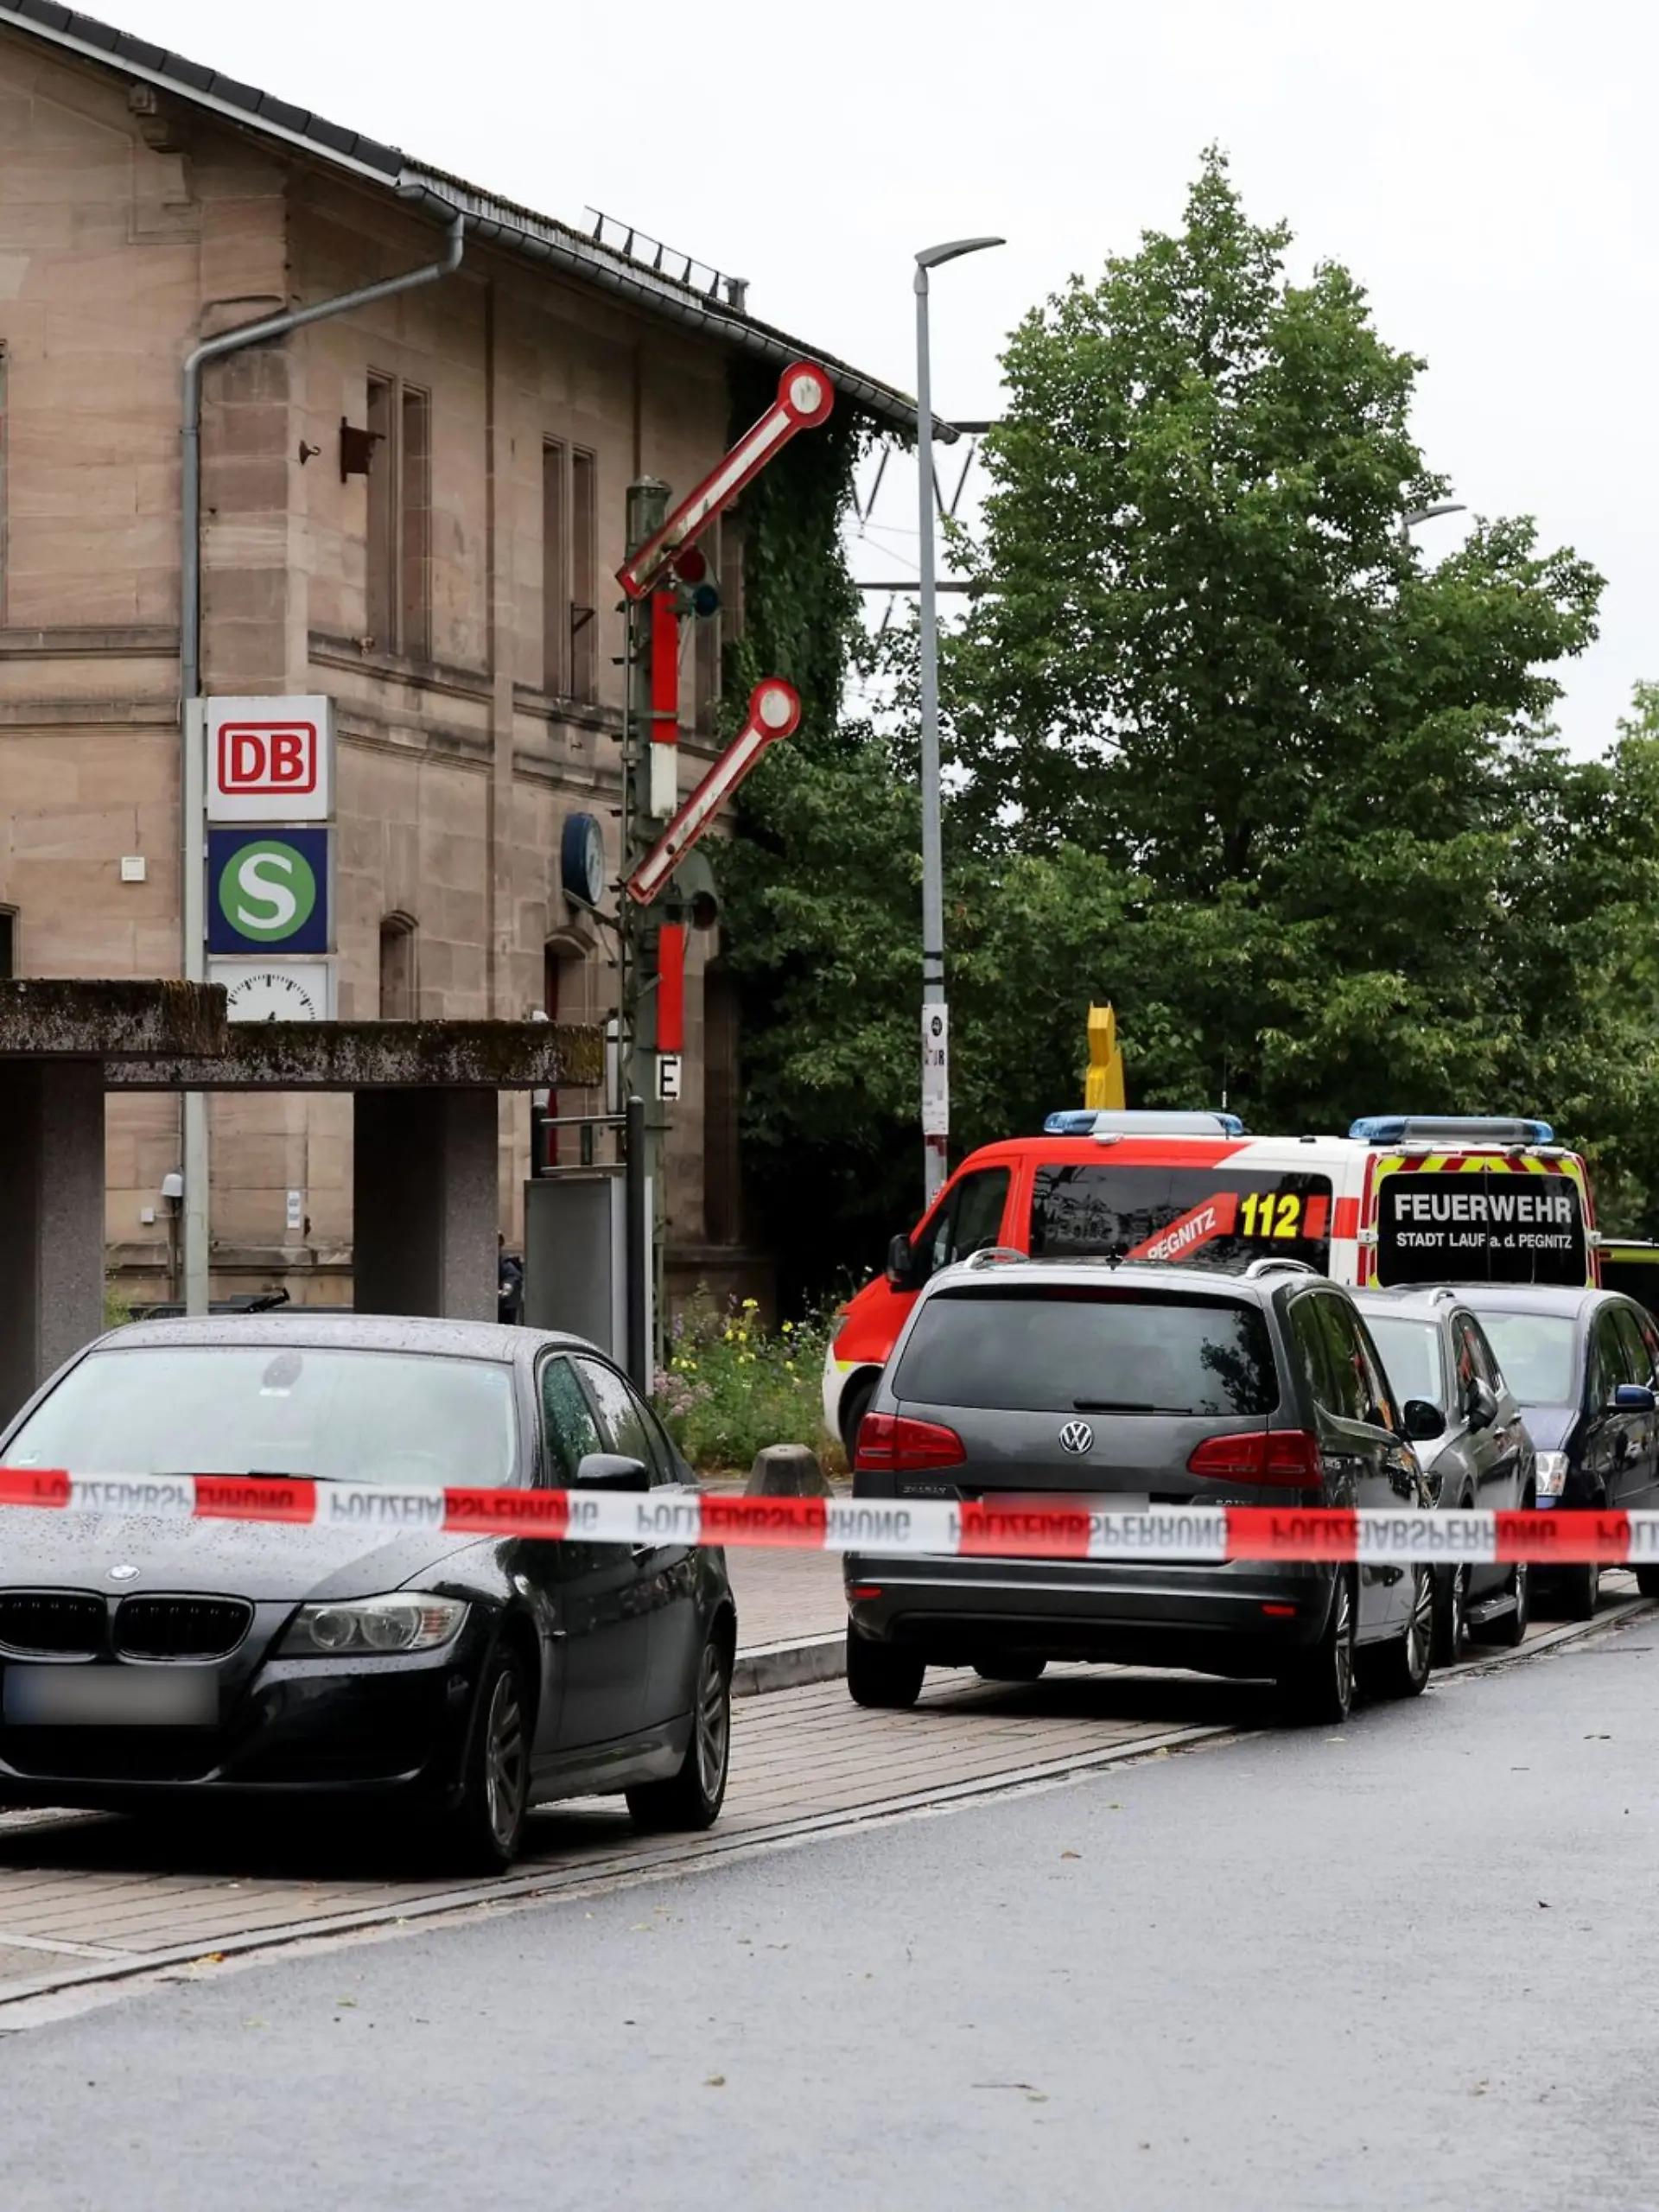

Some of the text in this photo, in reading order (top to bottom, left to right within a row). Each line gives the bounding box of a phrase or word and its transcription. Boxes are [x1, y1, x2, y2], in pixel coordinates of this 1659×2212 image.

[231, 734, 304, 782] DB
[238, 853, 296, 930] S
[660, 1059, 677, 1096] E
[1241, 1192, 1300, 1237] 112
[1394, 1193, 1572, 1224] FEUERWEHR
[1147, 1206, 1217, 1259] PEGNITZ
[1396, 1232, 1572, 1249] STADT LAUF a. d. PEGNITZ
